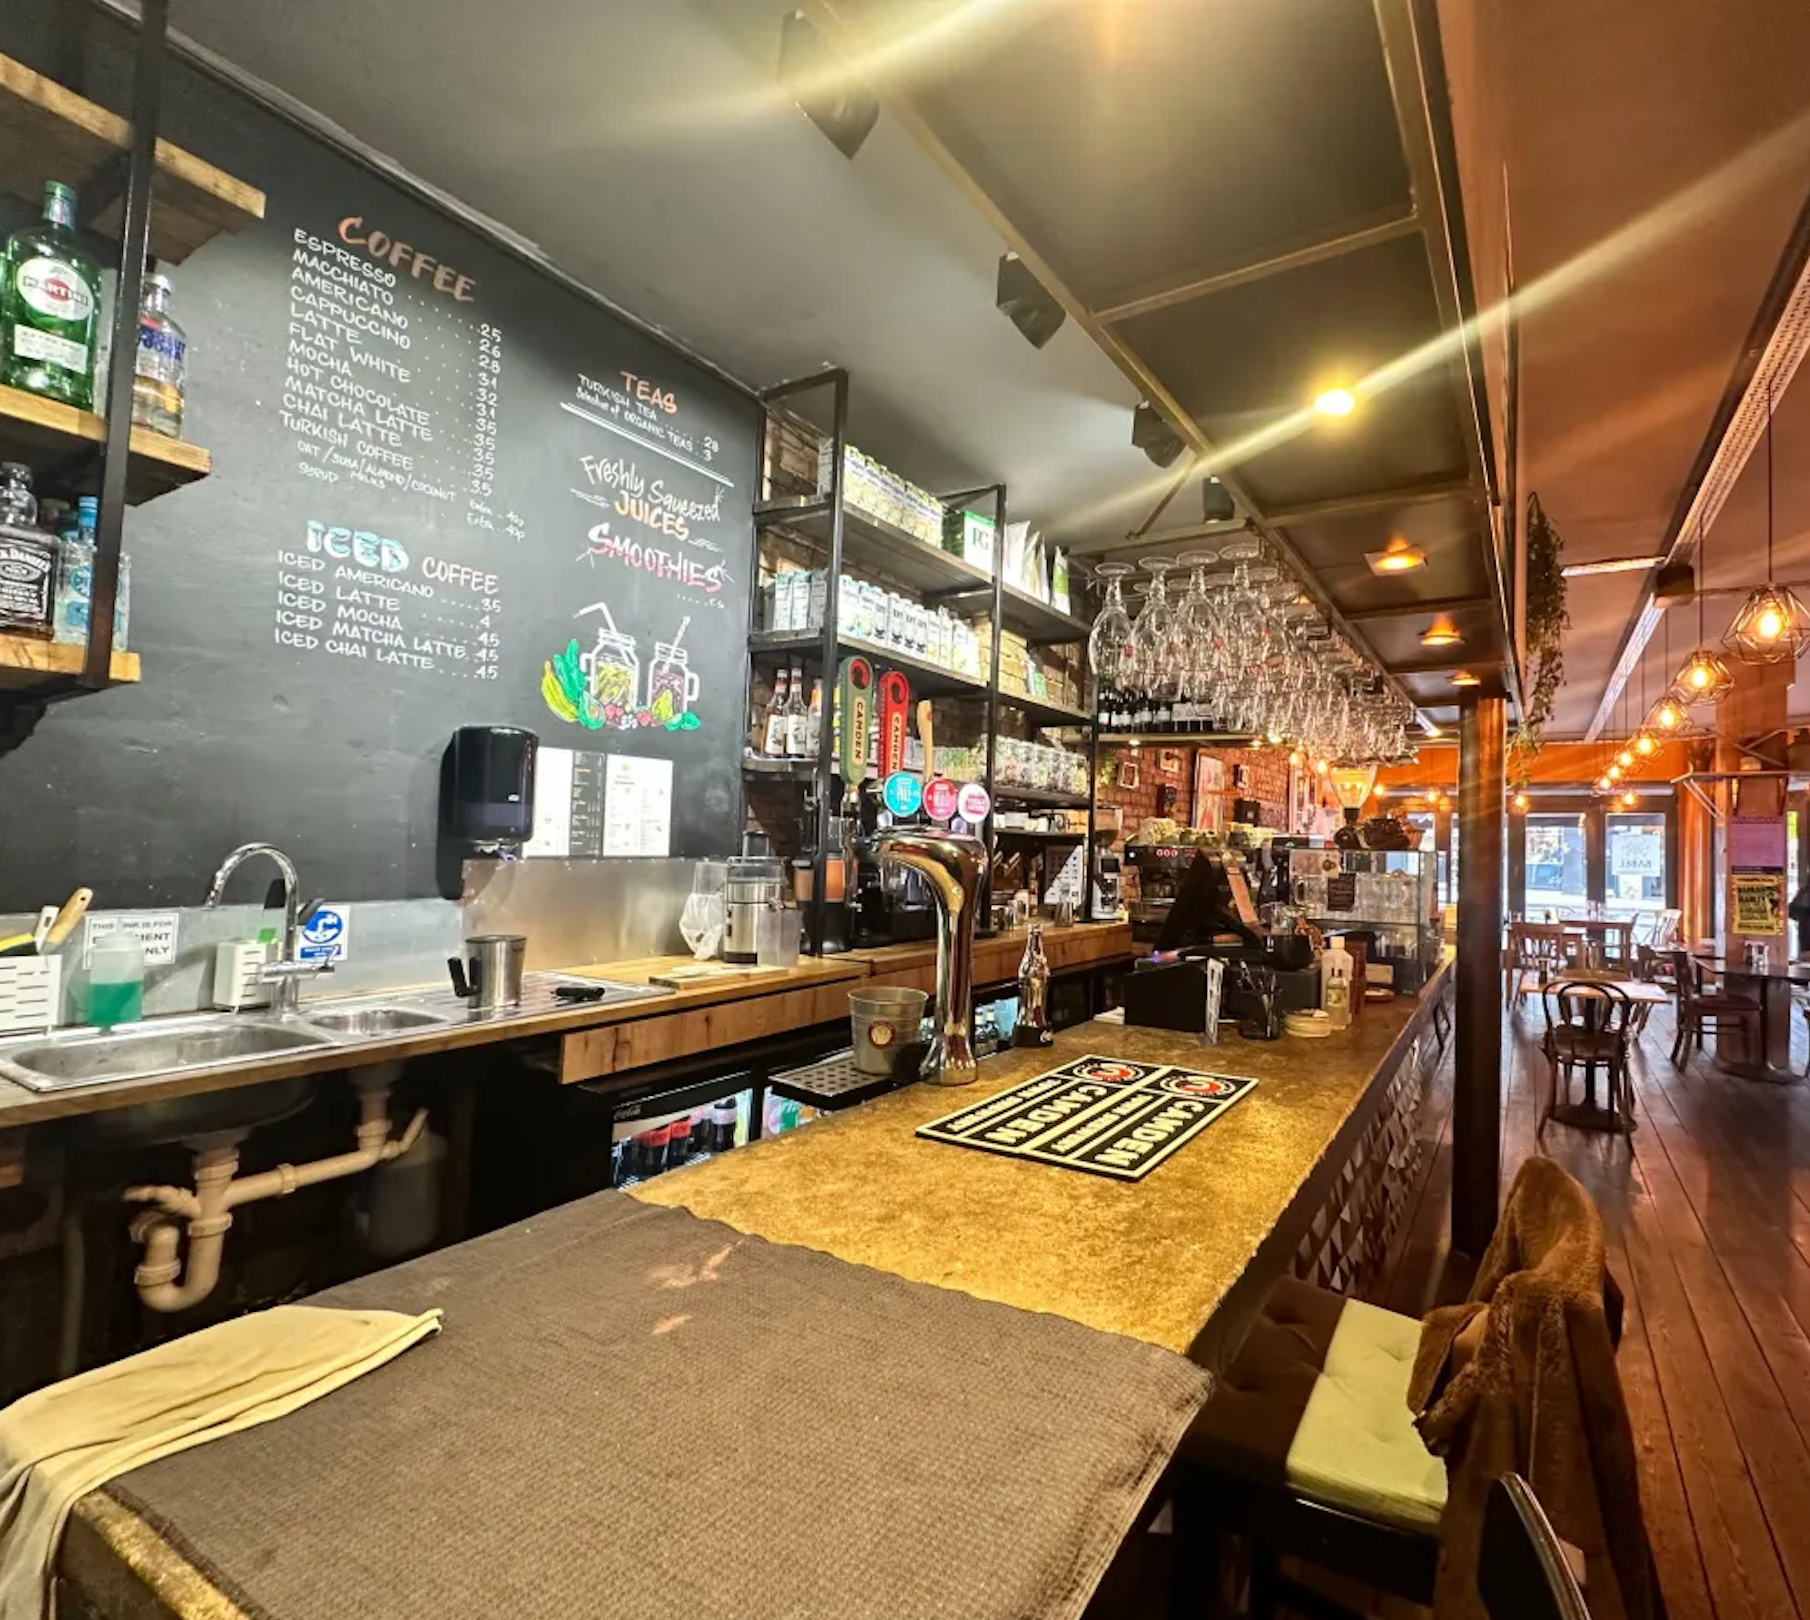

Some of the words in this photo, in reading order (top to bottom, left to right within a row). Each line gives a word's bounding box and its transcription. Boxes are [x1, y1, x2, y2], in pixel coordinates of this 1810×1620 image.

[292, 248, 394, 306] MACCHIATO
[293, 227, 397, 288] ESPRESSO
[338, 216, 476, 302] COFFEE
[290, 285, 411, 351] CAPPUCCINO
[291, 266, 409, 331] AMERICANO
[291, 302, 363, 345] LATTE
[287, 339, 352, 377] MOCHA
[288, 322, 339, 351] FLAT
[350, 347, 411, 383] WHITE
[282, 393, 328, 421] CHAI
[338, 412, 402, 448] LATTE
[284, 376, 366, 417] MATCHA
[376, 409, 434, 442] LATTE
[286, 357, 324, 382] HOT
[330, 374, 431, 426] CHOCOLATE
[577, 373, 630, 408] TURKISH
[635, 401, 658, 421] TEA
[619, 371, 679, 415] TEAS
[278, 409, 349, 449] TURKISH
[356, 441, 414, 471] COFFEE
[624, 410, 666, 439] ORGANIC
[667, 431, 694, 452] TEAS
[579, 455, 646, 499] Freshly
[648, 480, 721, 523] Squeezed
[613, 489, 690, 542] JUICES
[277, 550, 327, 572] ICED
[335, 565, 434, 598] AMERICANO
[306, 520, 411, 573] ICED
[421, 556, 500, 596] COFFEE
[587, 522, 723, 594] SMOOTHIES
[277, 590, 327, 613] ICED
[337, 605, 404, 631] MOCHA
[278, 570, 326, 595] ICED
[335, 586, 401, 612] LATTE
[479, 614, 491, 629] 4
[273, 628, 319, 650] ICED
[325, 640, 367, 659] CHAI
[376, 648, 436, 670] LATTE
[275, 609, 323, 631] ICED
[331, 621, 407, 649] MATCHA
[413, 637, 467, 660] LATTE
[855, 702, 864, 759] CAMDEN
[984, 1084, 1107, 1145] CAMDEN
[1094, 1100, 1206, 1168] CAMDEN
